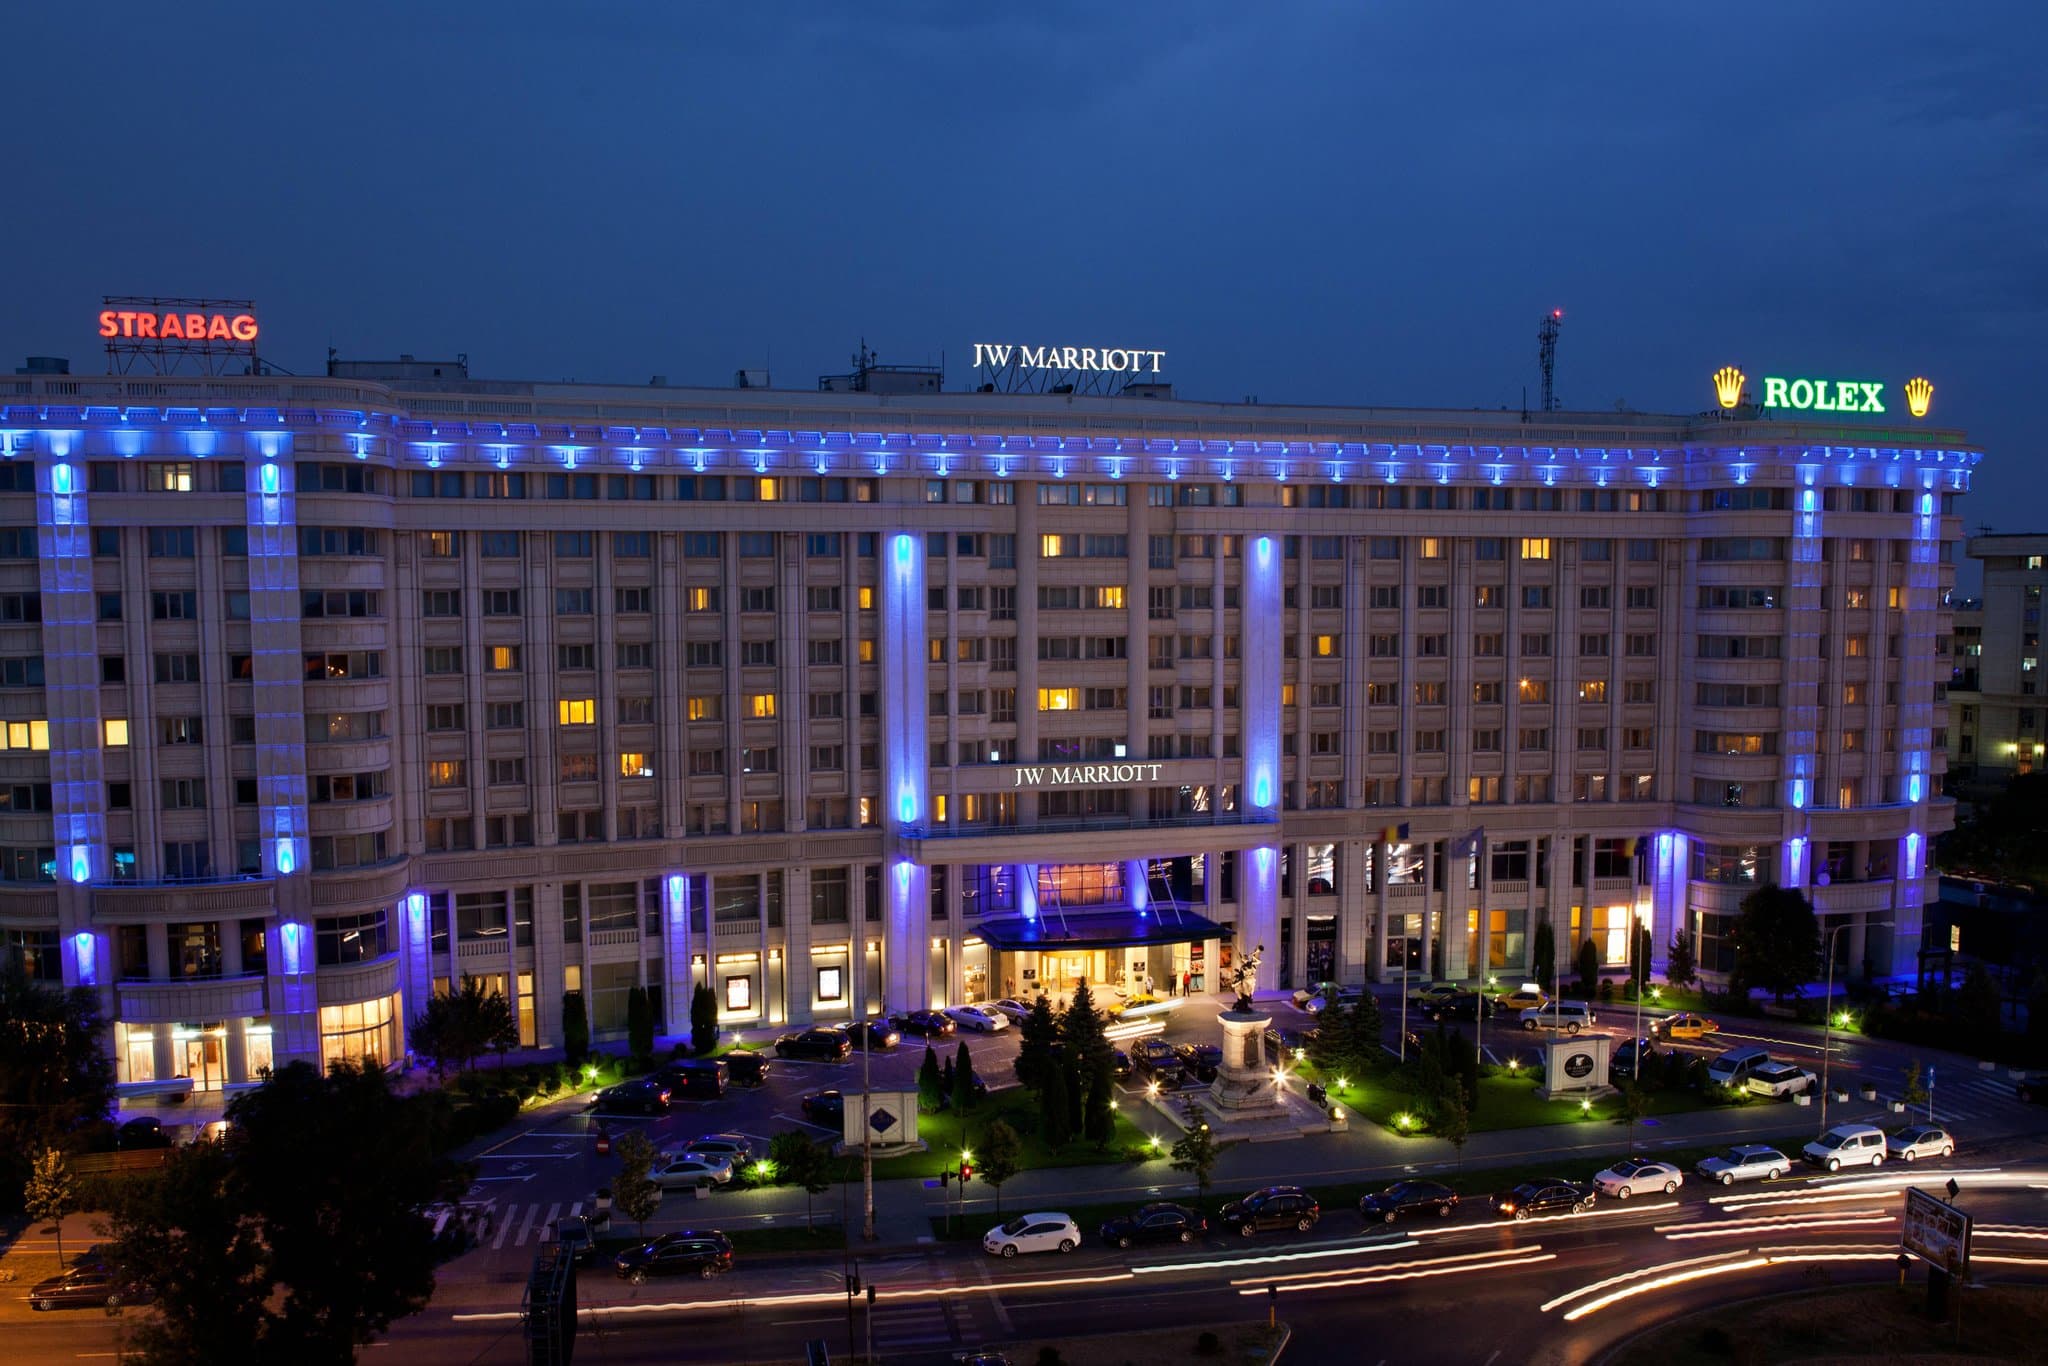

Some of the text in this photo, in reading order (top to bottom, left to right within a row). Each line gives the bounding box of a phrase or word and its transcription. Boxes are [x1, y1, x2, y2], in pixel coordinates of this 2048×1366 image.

[99, 311, 259, 341] STRABAG
[973, 343, 1166, 373] JW MARRIOTT
[1763, 377, 1886, 412] ROLEX
[1015, 764, 1163, 787] JW MARRIOTT
